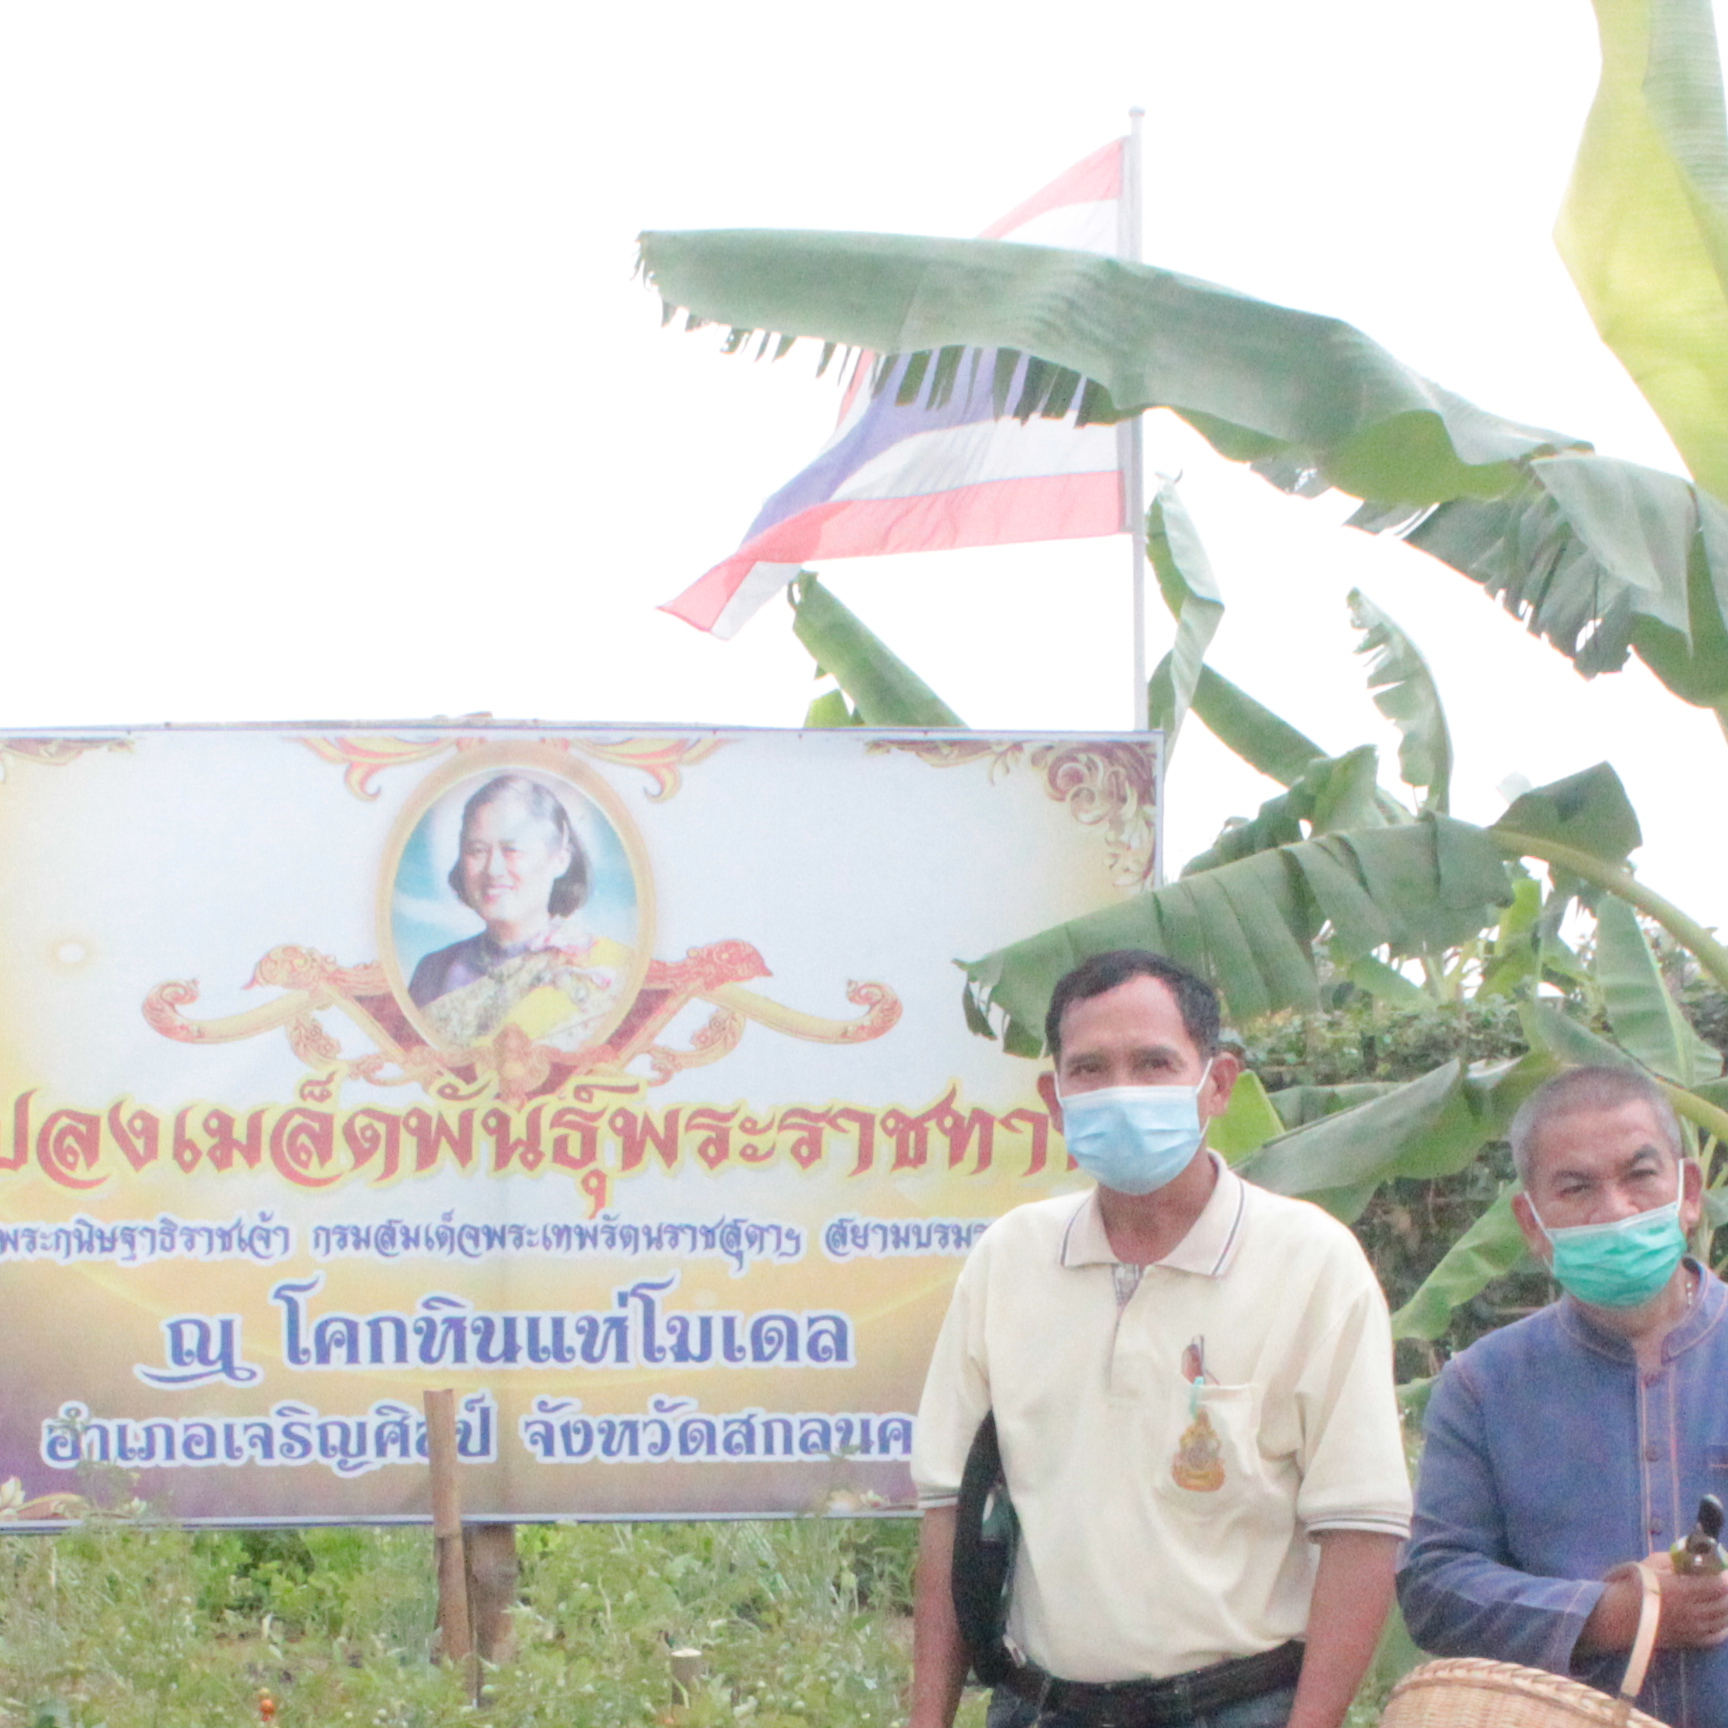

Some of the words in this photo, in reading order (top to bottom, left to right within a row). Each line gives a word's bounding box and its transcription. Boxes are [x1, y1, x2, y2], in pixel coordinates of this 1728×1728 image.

[824, 1217, 989, 1258] สยามบรม
[139, 1317, 258, 1384] ณ
[523, 1398, 913, 1459] จังหวัดสกลนค
